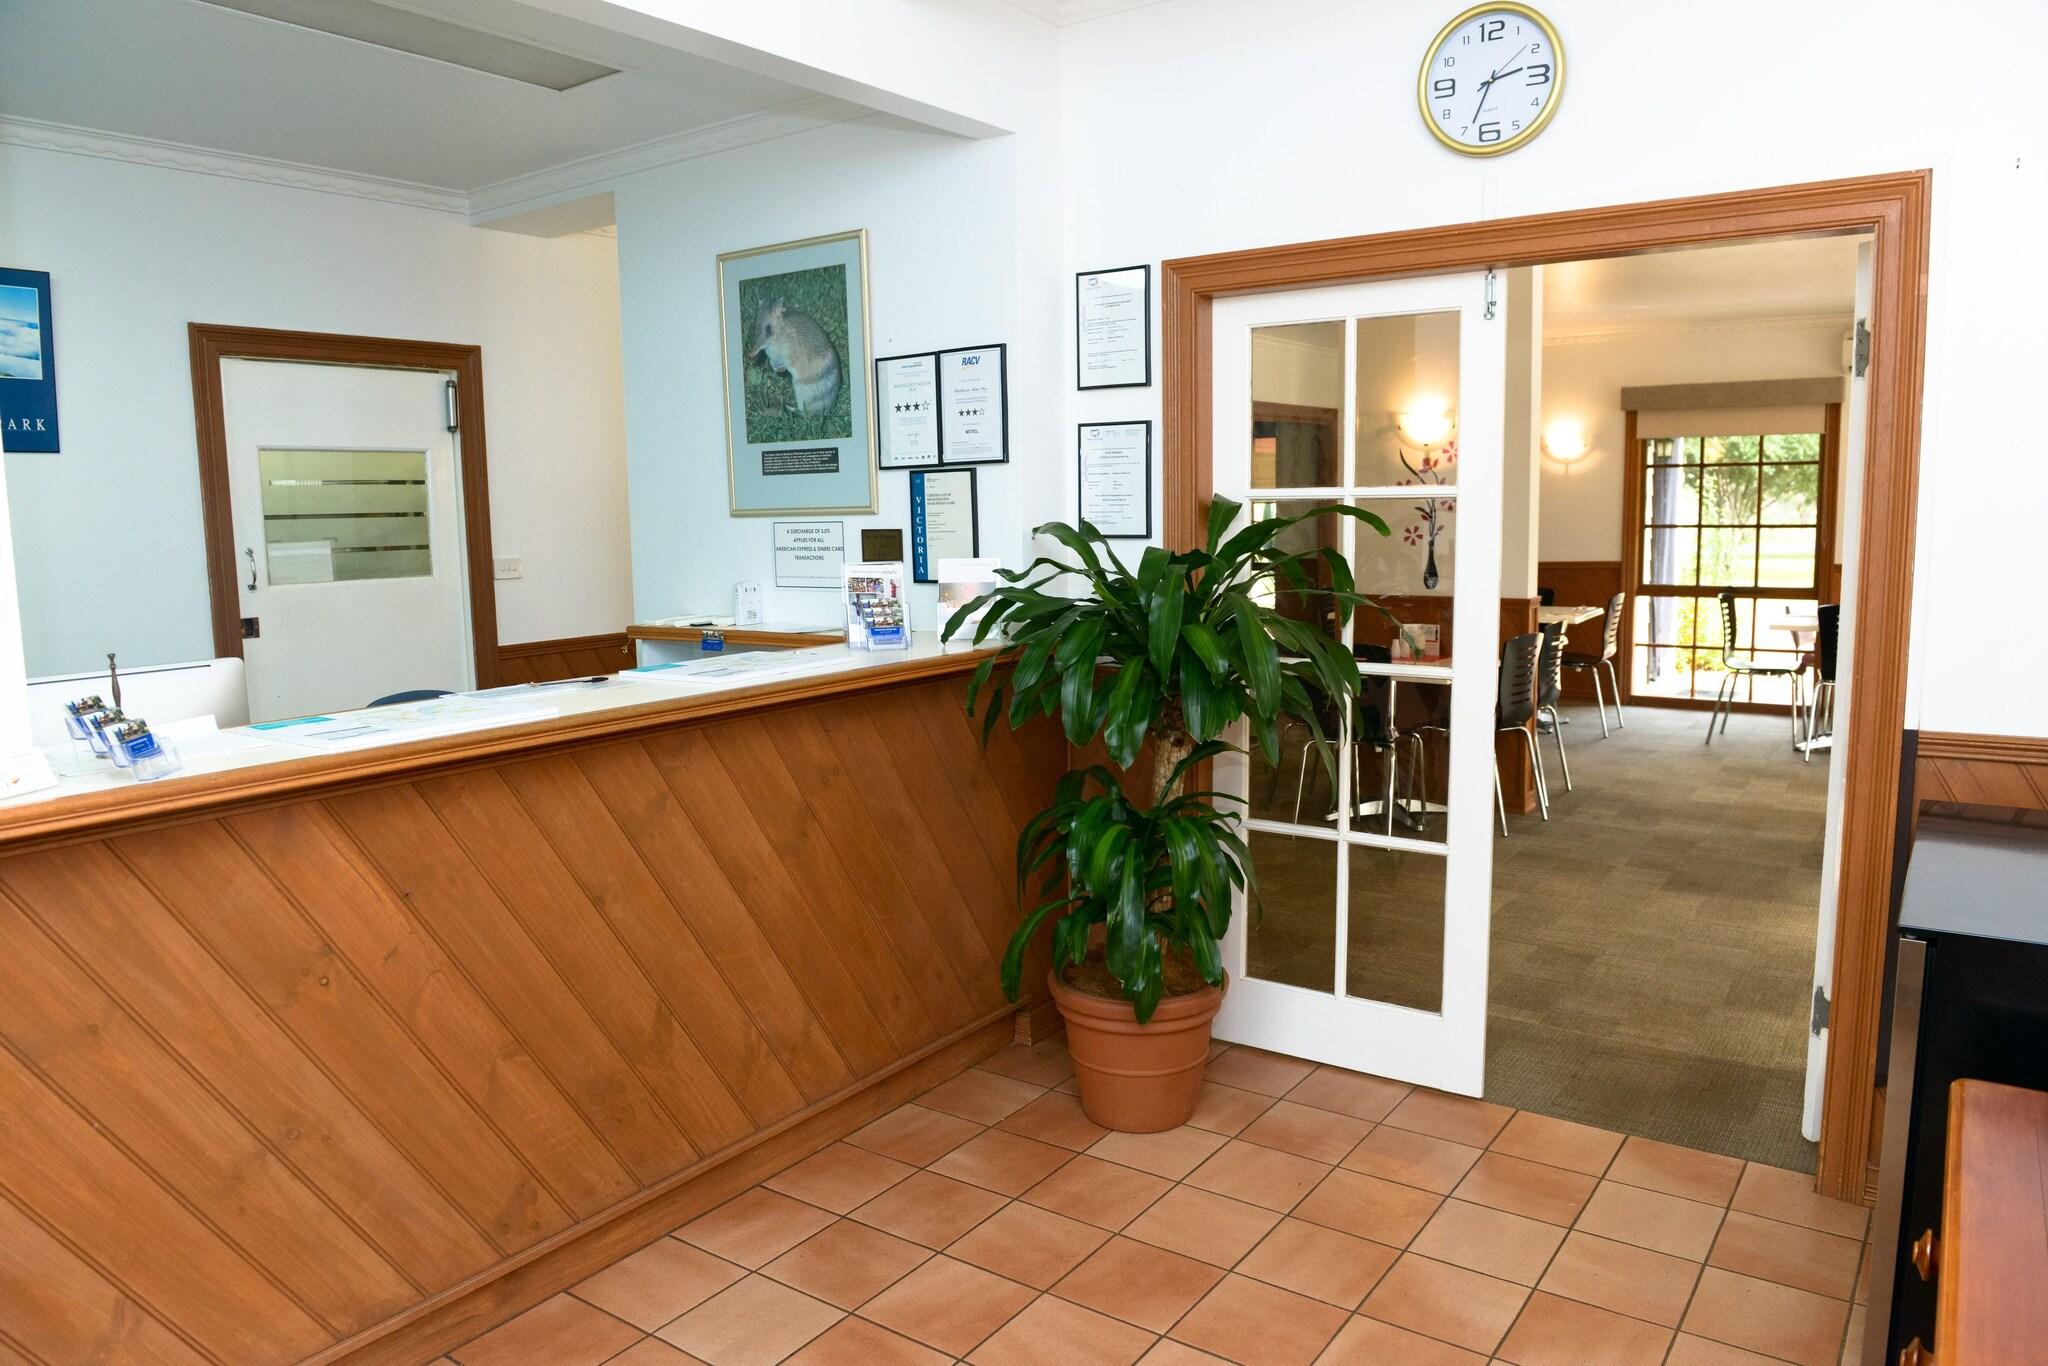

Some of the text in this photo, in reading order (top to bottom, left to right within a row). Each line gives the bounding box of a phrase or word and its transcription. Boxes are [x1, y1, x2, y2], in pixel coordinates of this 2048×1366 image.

[1479, 20, 1506, 43] 12
[1516, 26, 1520, 35] 1
[1462, 35, 1470, 46] 11
[1531, 43, 1540, 54] 2
[1443, 56, 1455, 67] 10
[1525, 63, 1550, 86] 3
[1434, 78, 1456, 99] 9
[1530, 97, 1539, 107] 4
[1442, 109, 1451, 120] 8
[1512, 120, 1520, 130] 5
[1460, 126, 1468, 136] 7
[1478, 121, 1501, 143] 6
[961, 356, 981, 366] RACV
[915, 496, 925, 574] VICTORIA
